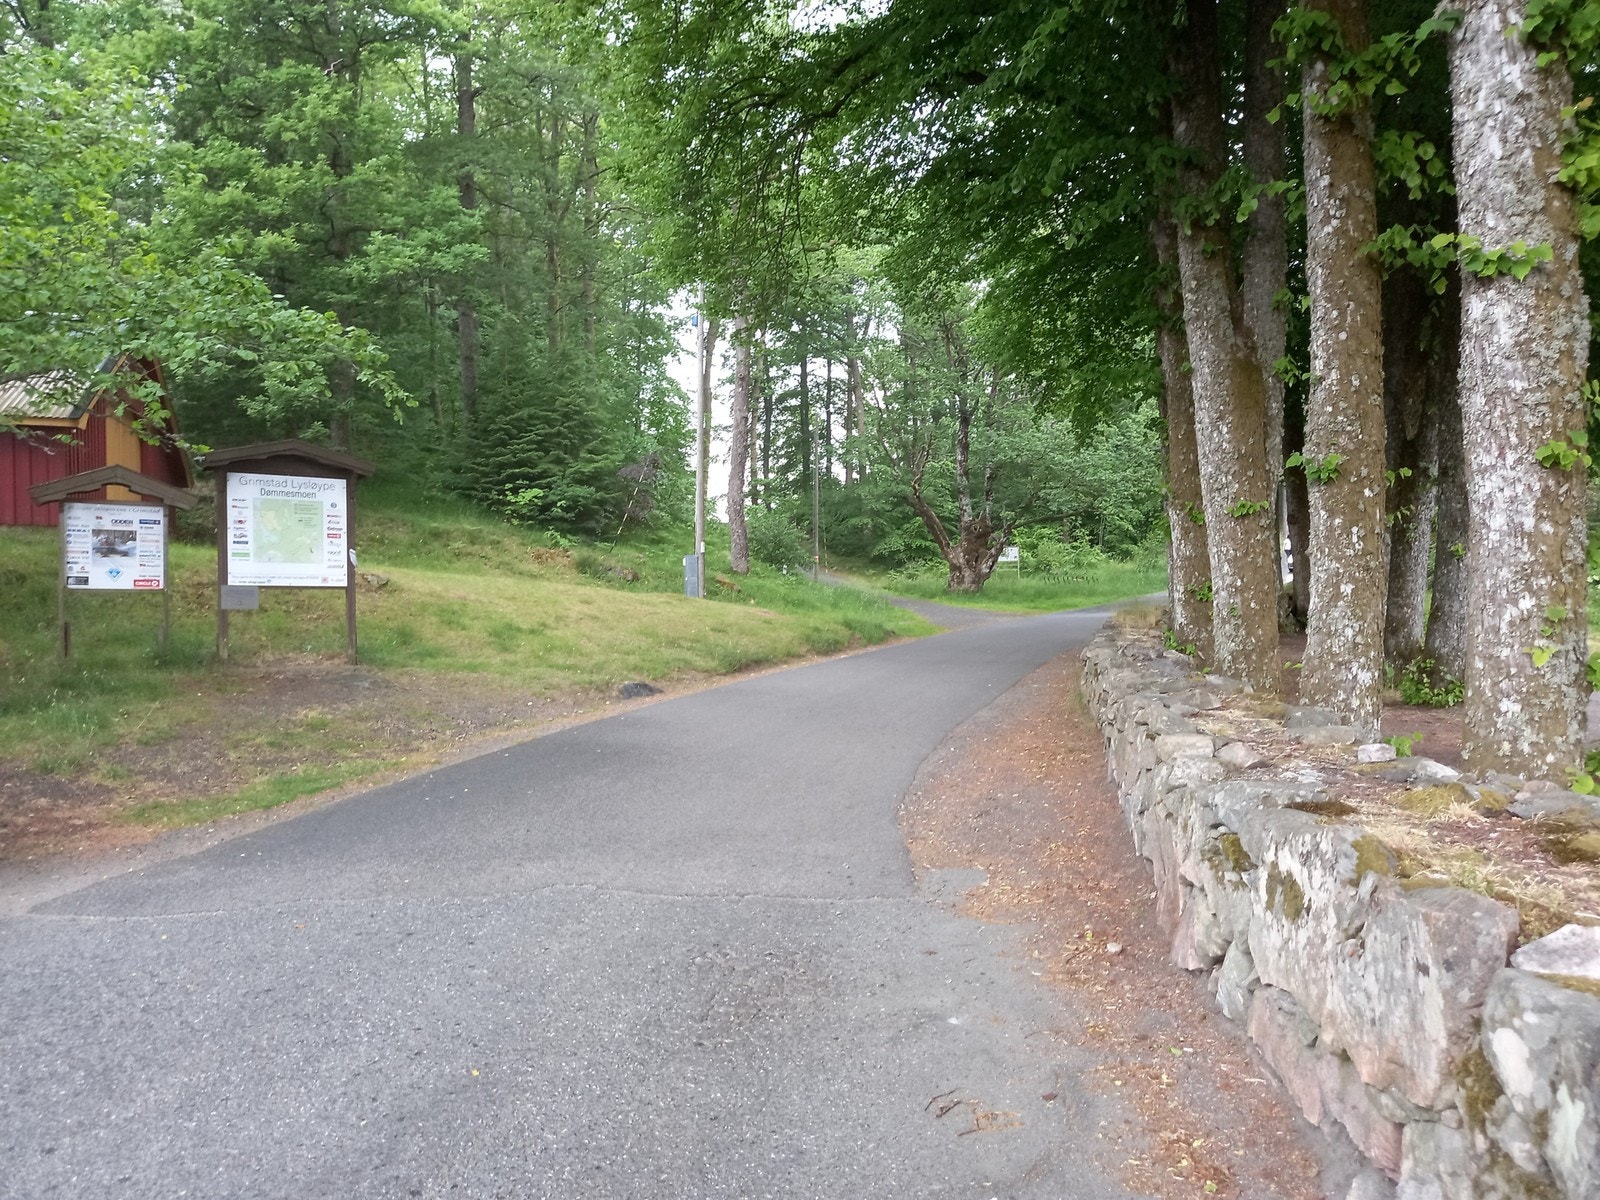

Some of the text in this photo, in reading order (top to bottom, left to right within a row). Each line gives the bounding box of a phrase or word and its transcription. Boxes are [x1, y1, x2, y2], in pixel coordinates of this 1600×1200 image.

[239, 476, 336, 492] Grimstad Lysløype
[260, 488, 317, 498] Dømmesmoen
